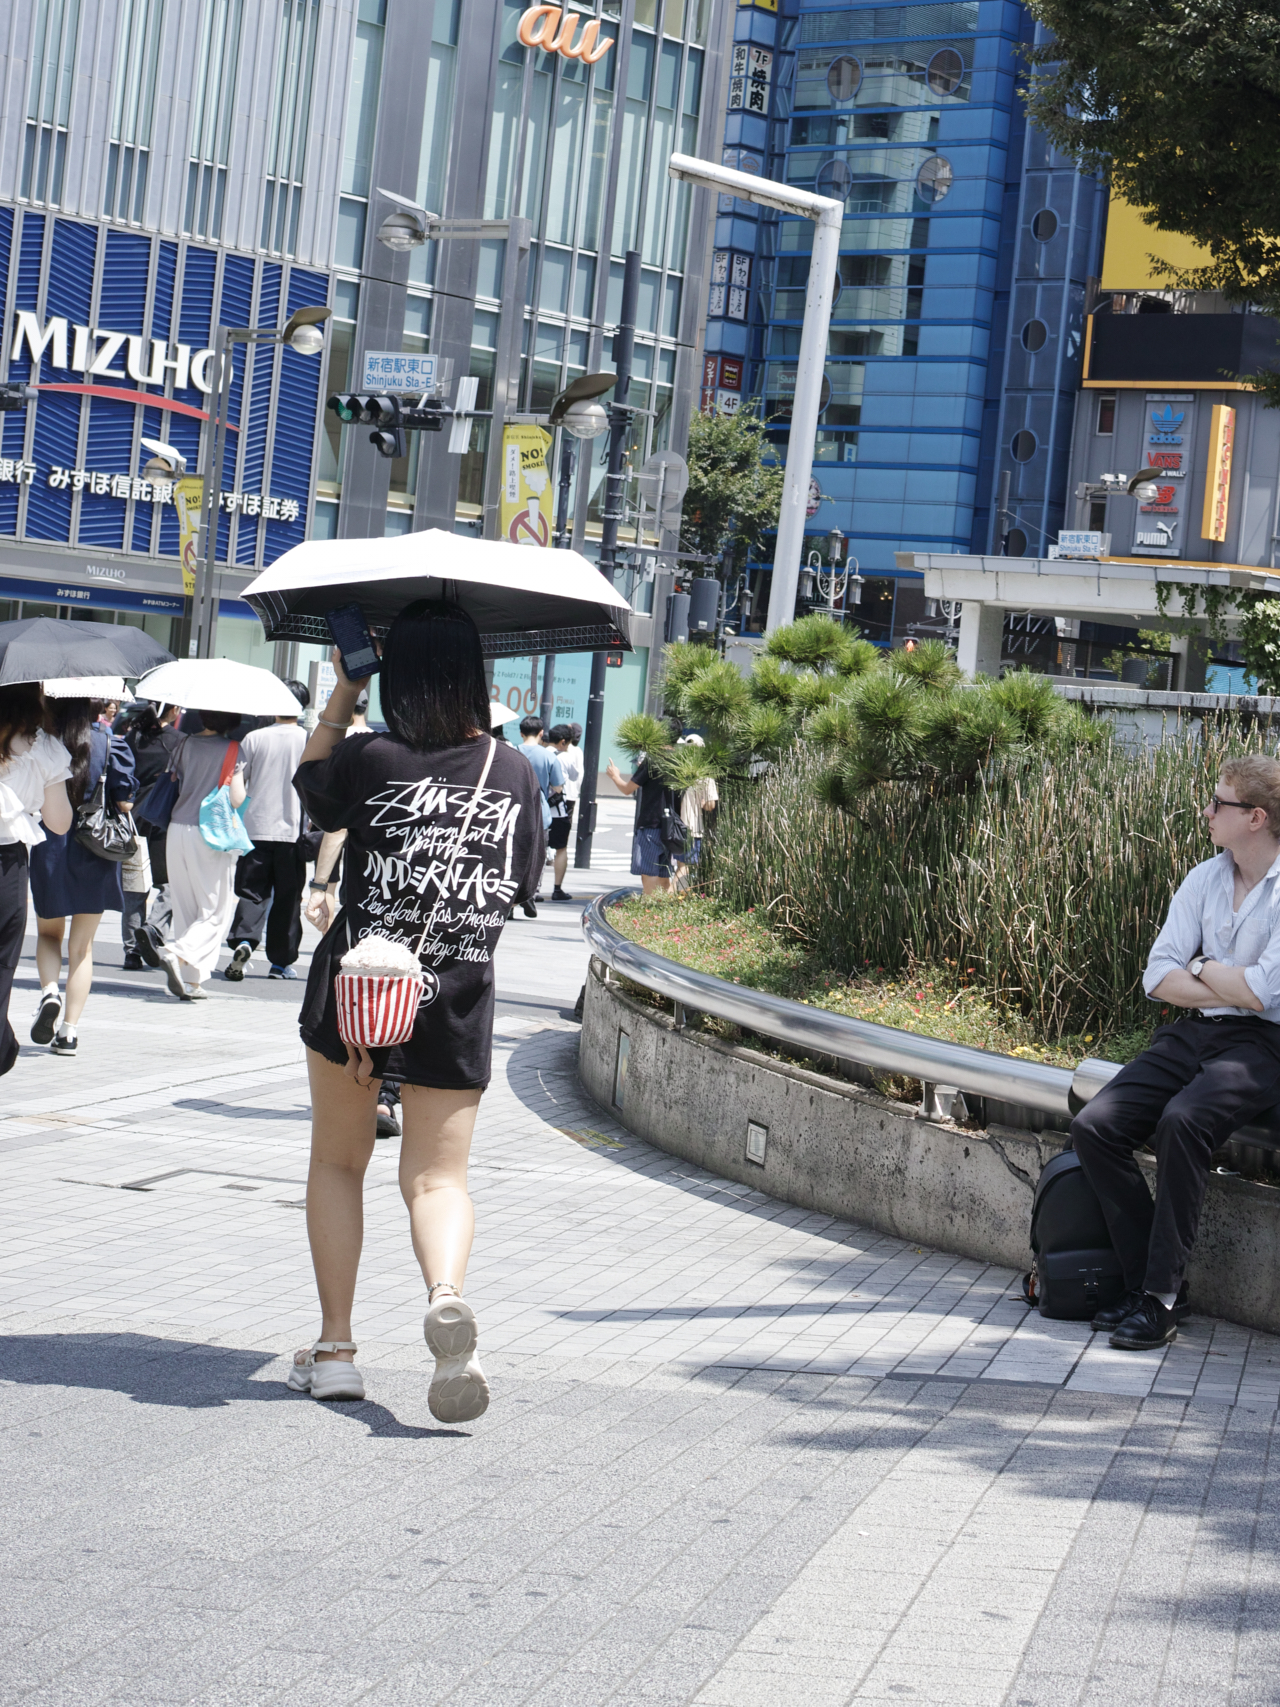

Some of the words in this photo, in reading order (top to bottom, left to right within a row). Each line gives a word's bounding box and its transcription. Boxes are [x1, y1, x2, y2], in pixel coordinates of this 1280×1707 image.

[516, 5, 615, 64] au
[754, 50, 768, 65] 7F
[731, 47, 746, 107] 和牛焼肉
[749, 67, 767, 111] 焼肉
[715, 253, 727, 263] 5F
[735, 256, 747, 265] 5F
[11, 309, 233, 394] MIZUHO
[367, 356, 434, 375] 新宿駅東口
[366, 373, 403, 388] Shinjuku
[724, 397, 738, 409] 4F
[1149, 433, 1183, 444] adidas
[520, 447, 544, 462] NO!
[1146, 452, 1182, 468] VANS
[49, 465, 179, 505] みずほ信託銀
[1153, 504, 1179, 514] balance
[1060, 534, 1099, 544] 新宿駅東口
[1136, 532, 1168, 546] PUMA
[1059, 544, 1082, 554] Shinjuku
[85, 564, 126, 579] MIZUHO
[56, 588, 91, 600] みずほ銀行
[555, 706, 574, 719] 割引
[358, 886, 390, 916] New
[384, 896, 422, 927] York
[423, 900, 454, 924] Los
